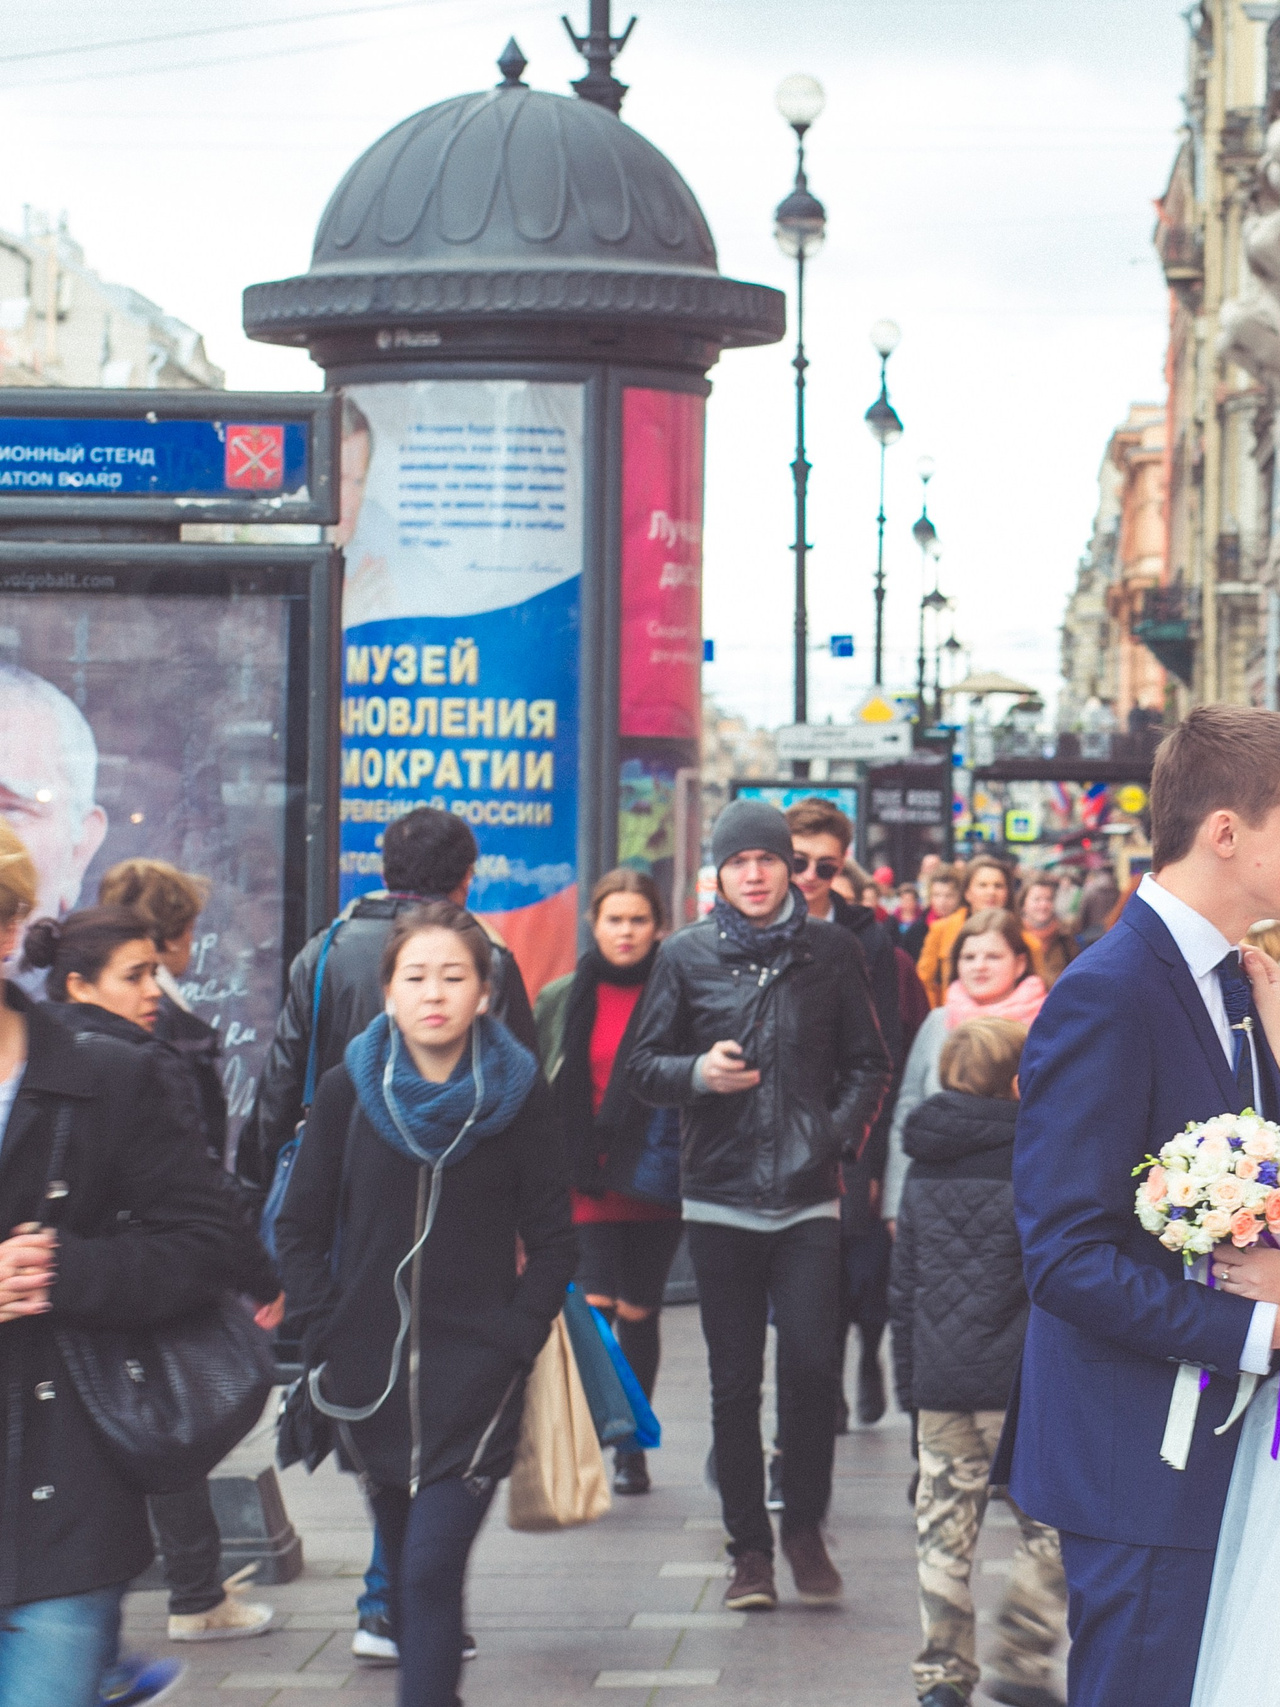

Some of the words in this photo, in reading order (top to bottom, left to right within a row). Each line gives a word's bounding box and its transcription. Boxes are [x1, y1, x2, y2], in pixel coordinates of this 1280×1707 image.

[90, 446, 156, 466] СТЕНД
[58, 470, 123, 488] BOARD
[345, 637, 480, 686] МУЗЕЙ
[451, 799, 554, 825] РОССИИ
